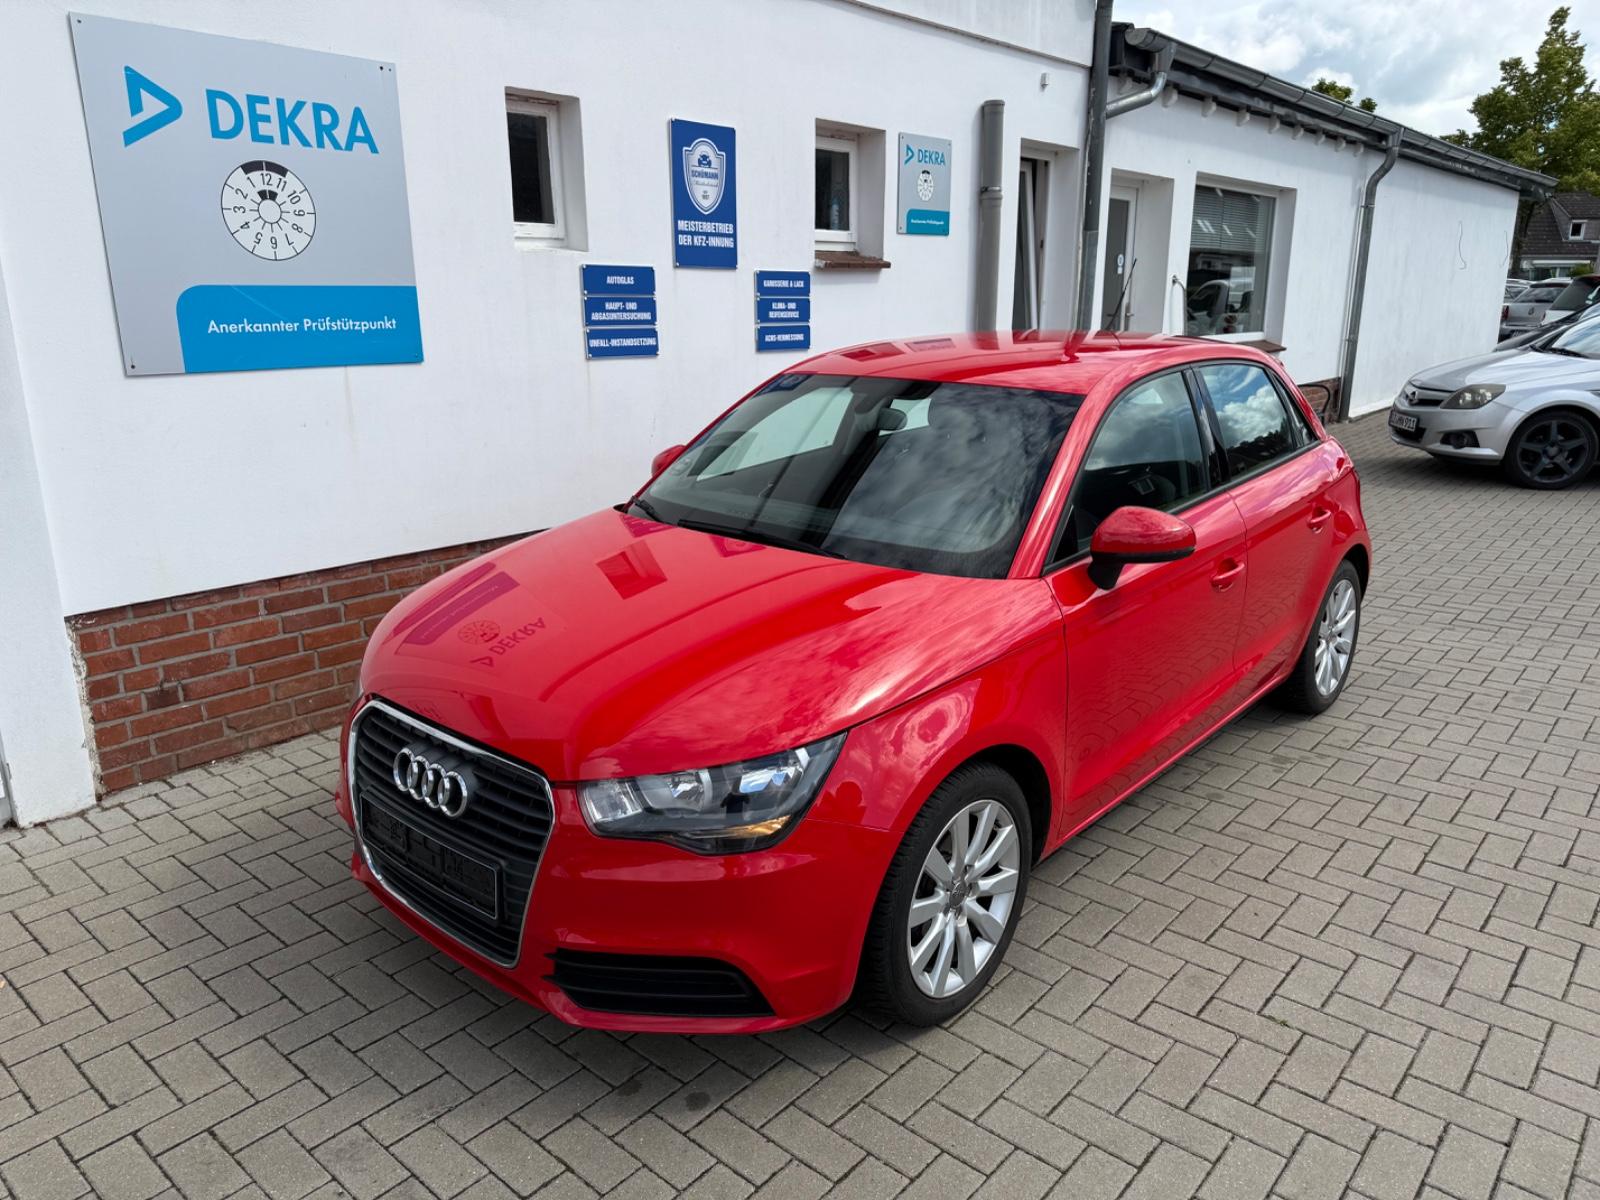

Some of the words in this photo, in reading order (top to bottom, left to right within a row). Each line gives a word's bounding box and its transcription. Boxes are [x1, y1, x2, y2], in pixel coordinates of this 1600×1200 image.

[206, 88, 379, 154] DEKRA
[917, 148, 946, 166] DEKRA
[246, 176, 256, 188] 1
[260, 173, 273, 186] 12
[276, 177, 287, 192] 11
[235, 188, 248, 199] 2
[287, 190, 301, 205] 10
[233, 205, 246, 214] 3
[293, 209, 306, 217] 9
[240, 221, 250, 230] 4
[291, 223, 303, 233] 8
[678, 219, 734, 233] MEISTERBETRIEB
[253, 231, 263, 245] 5
[269, 236, 278, 249] 6
[284, 233, 294, 246] 7
[678, 234, 692, 246] DER
[693, 235, 734, 248] KFZ-INNUNG
[606, 275, 635, 285] AUTOGLAS
[605, 301, 625, 310] HAUPT-
[625, 302, 637, 310] UND
[591, 312, 652, 320] ABGASUNTERSUCHUNG
[208, 318, 299, 334] Anerkannter
[303, 316, 397, 333] Prüfstützpunkt
[588, 337, 657, 347] UNFALL-INSTANDSETZUNG
